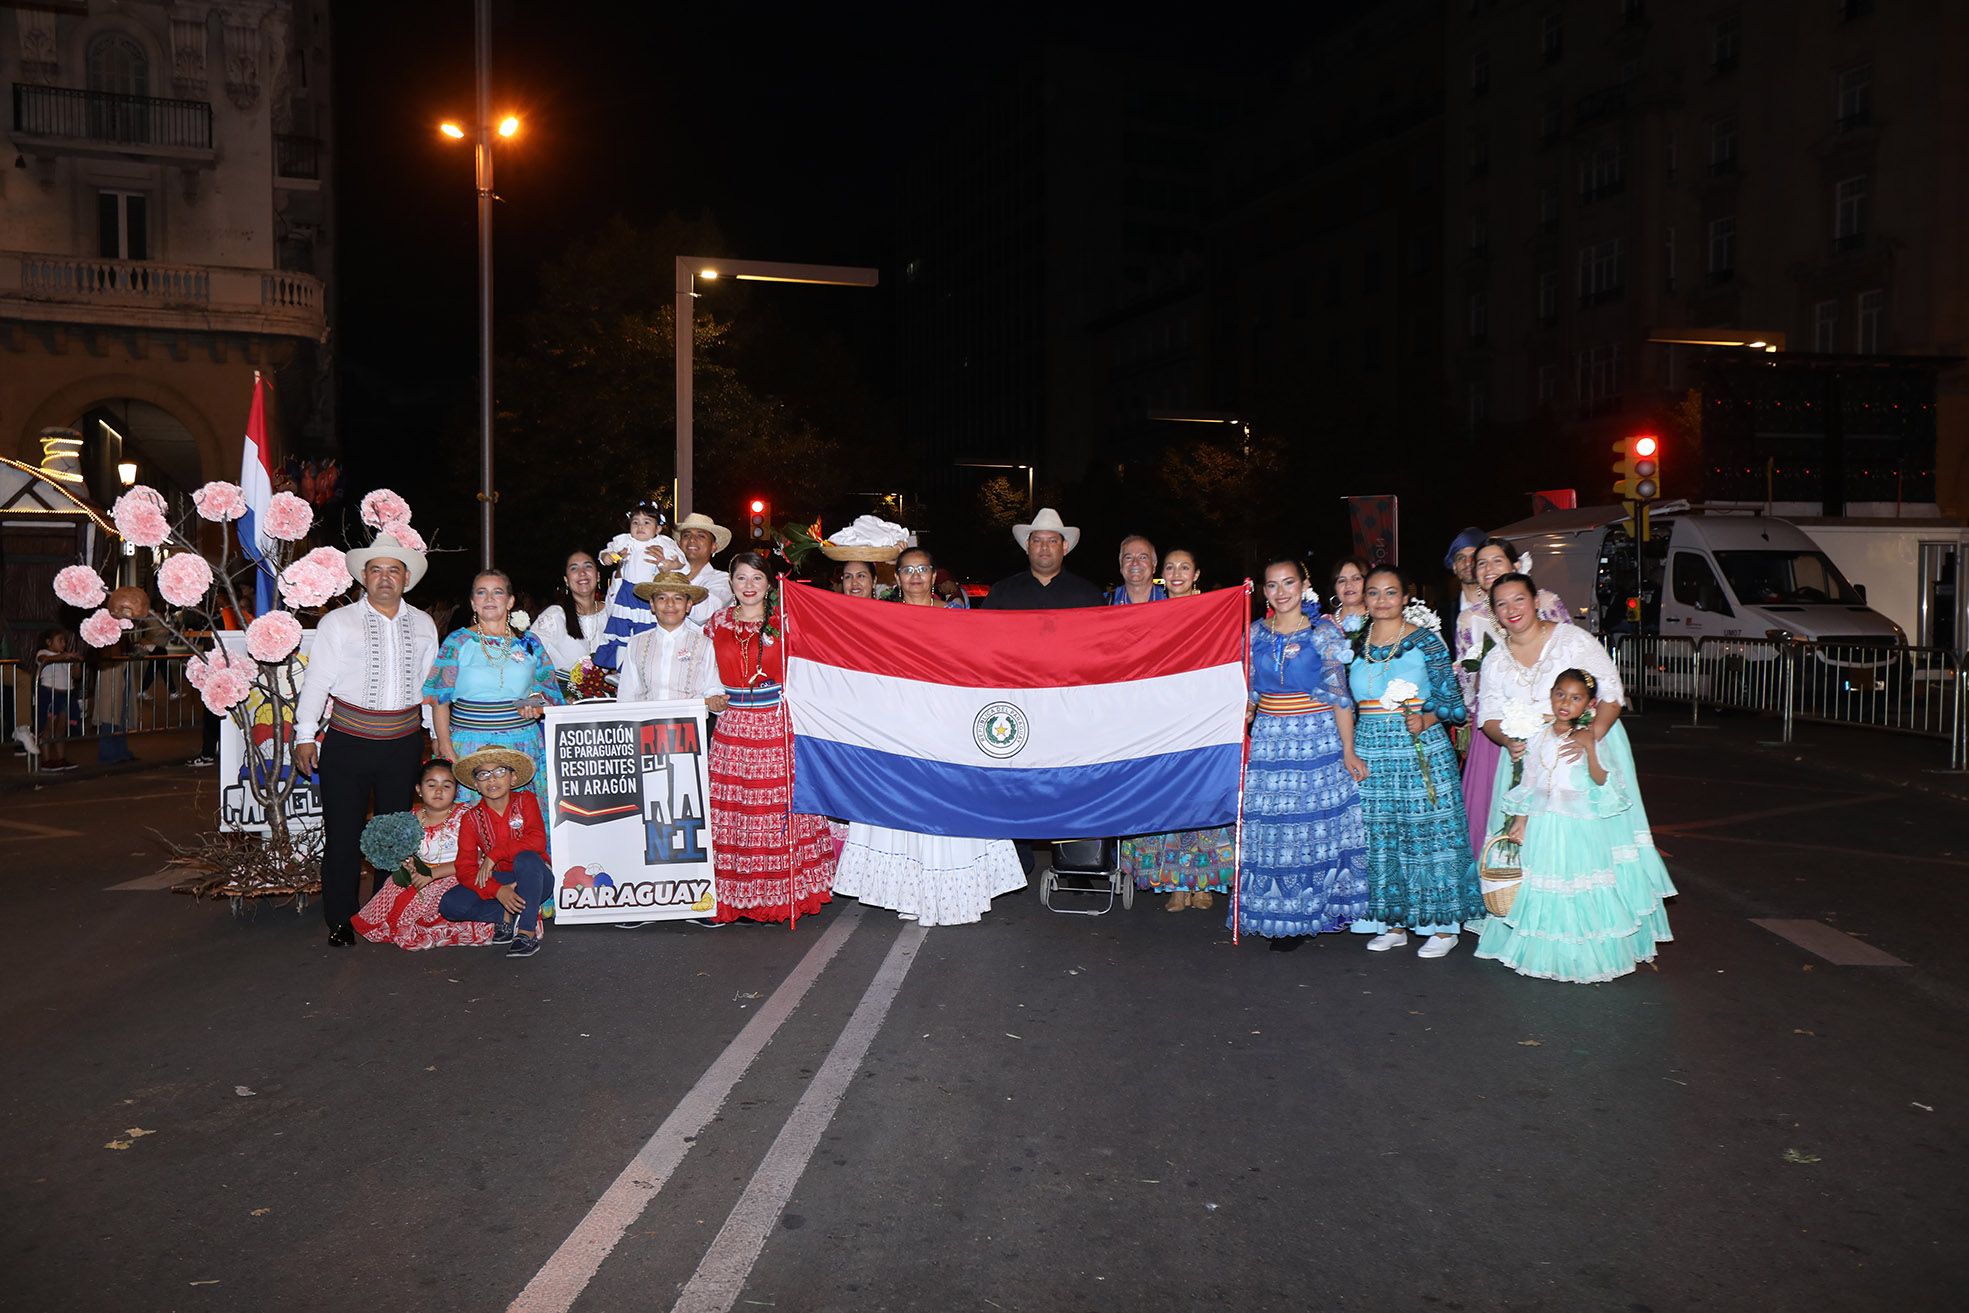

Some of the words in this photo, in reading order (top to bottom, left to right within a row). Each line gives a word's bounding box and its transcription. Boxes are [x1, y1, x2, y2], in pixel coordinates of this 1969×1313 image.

[559, 725, 634, 747] ASOCIACIÓN
[640, 723, 698, 755] RAZA
[560, 746, 573, 760] DE
[574, 743, 635, 758] PARAGUAYOS
[561, 759, 636, 777] RESIDENTES
[562, 780, 580, 797] EN
[584, 776, 637, 796] ARAGÓN
[560, 880, 712, 909] PARAGUAY
